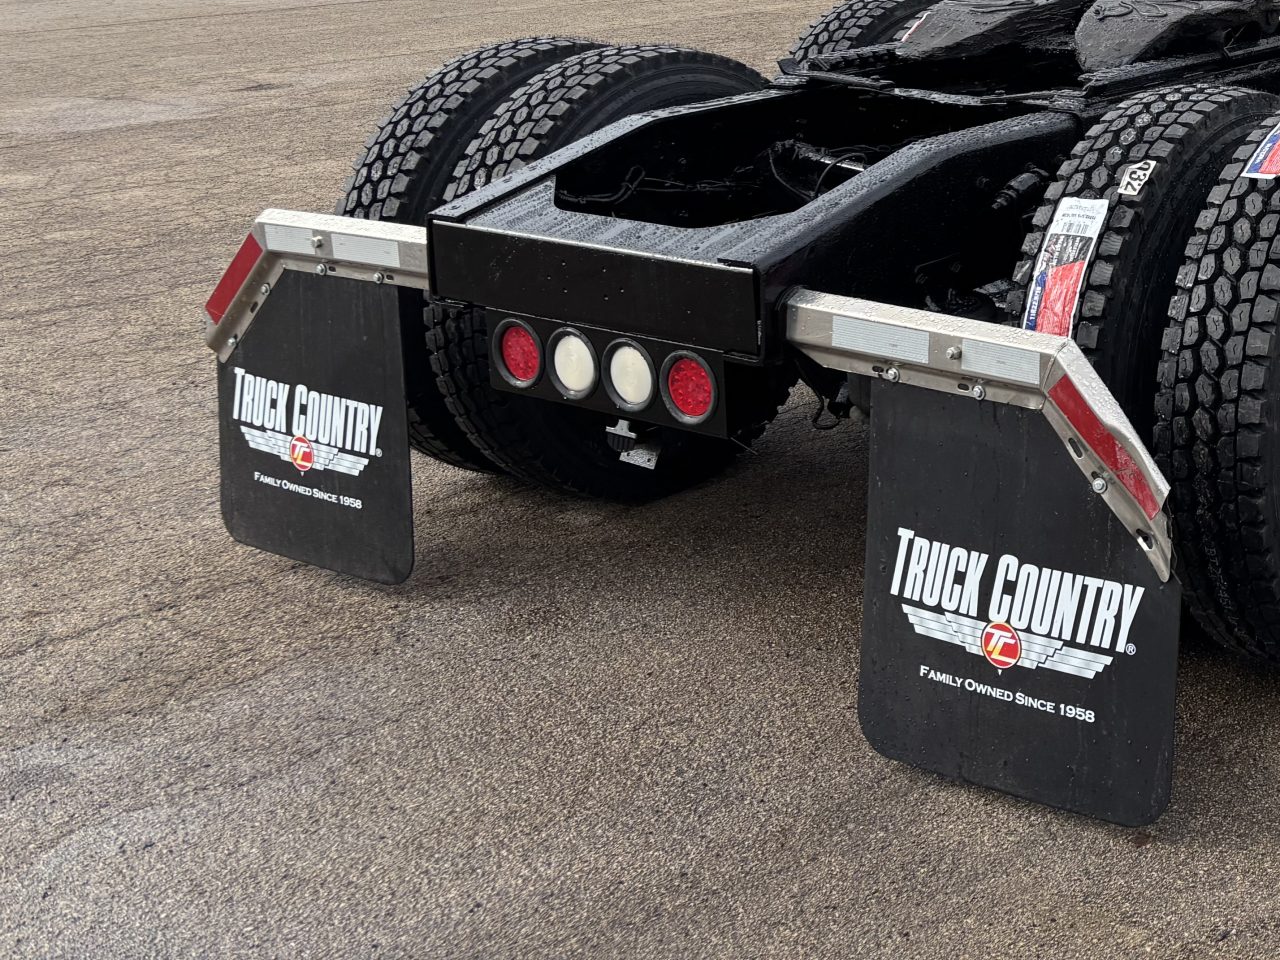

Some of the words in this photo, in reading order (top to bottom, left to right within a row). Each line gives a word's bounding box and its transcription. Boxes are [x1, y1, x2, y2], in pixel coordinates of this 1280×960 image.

[232, 366, 290, 433] TRUCK
[292, 384, 383, 456] COUNTRY
[254, 471, 281, 486] FAMILY
[281, 479, 312, 496] OWNED
[312, 488, 338, 504] SINCE
[339, 495, 362, 509] 1958
[890, 527, 989, 617] TRUCK
[988, 554, 1145, 653] COUNTRY
[919, 664, 964, 688] FAMILY
[964, 678, 1014, 702] OWNED
[1015, 692, 1056, 714] SINCE
[1058, 703, 1096, 723] 1958
